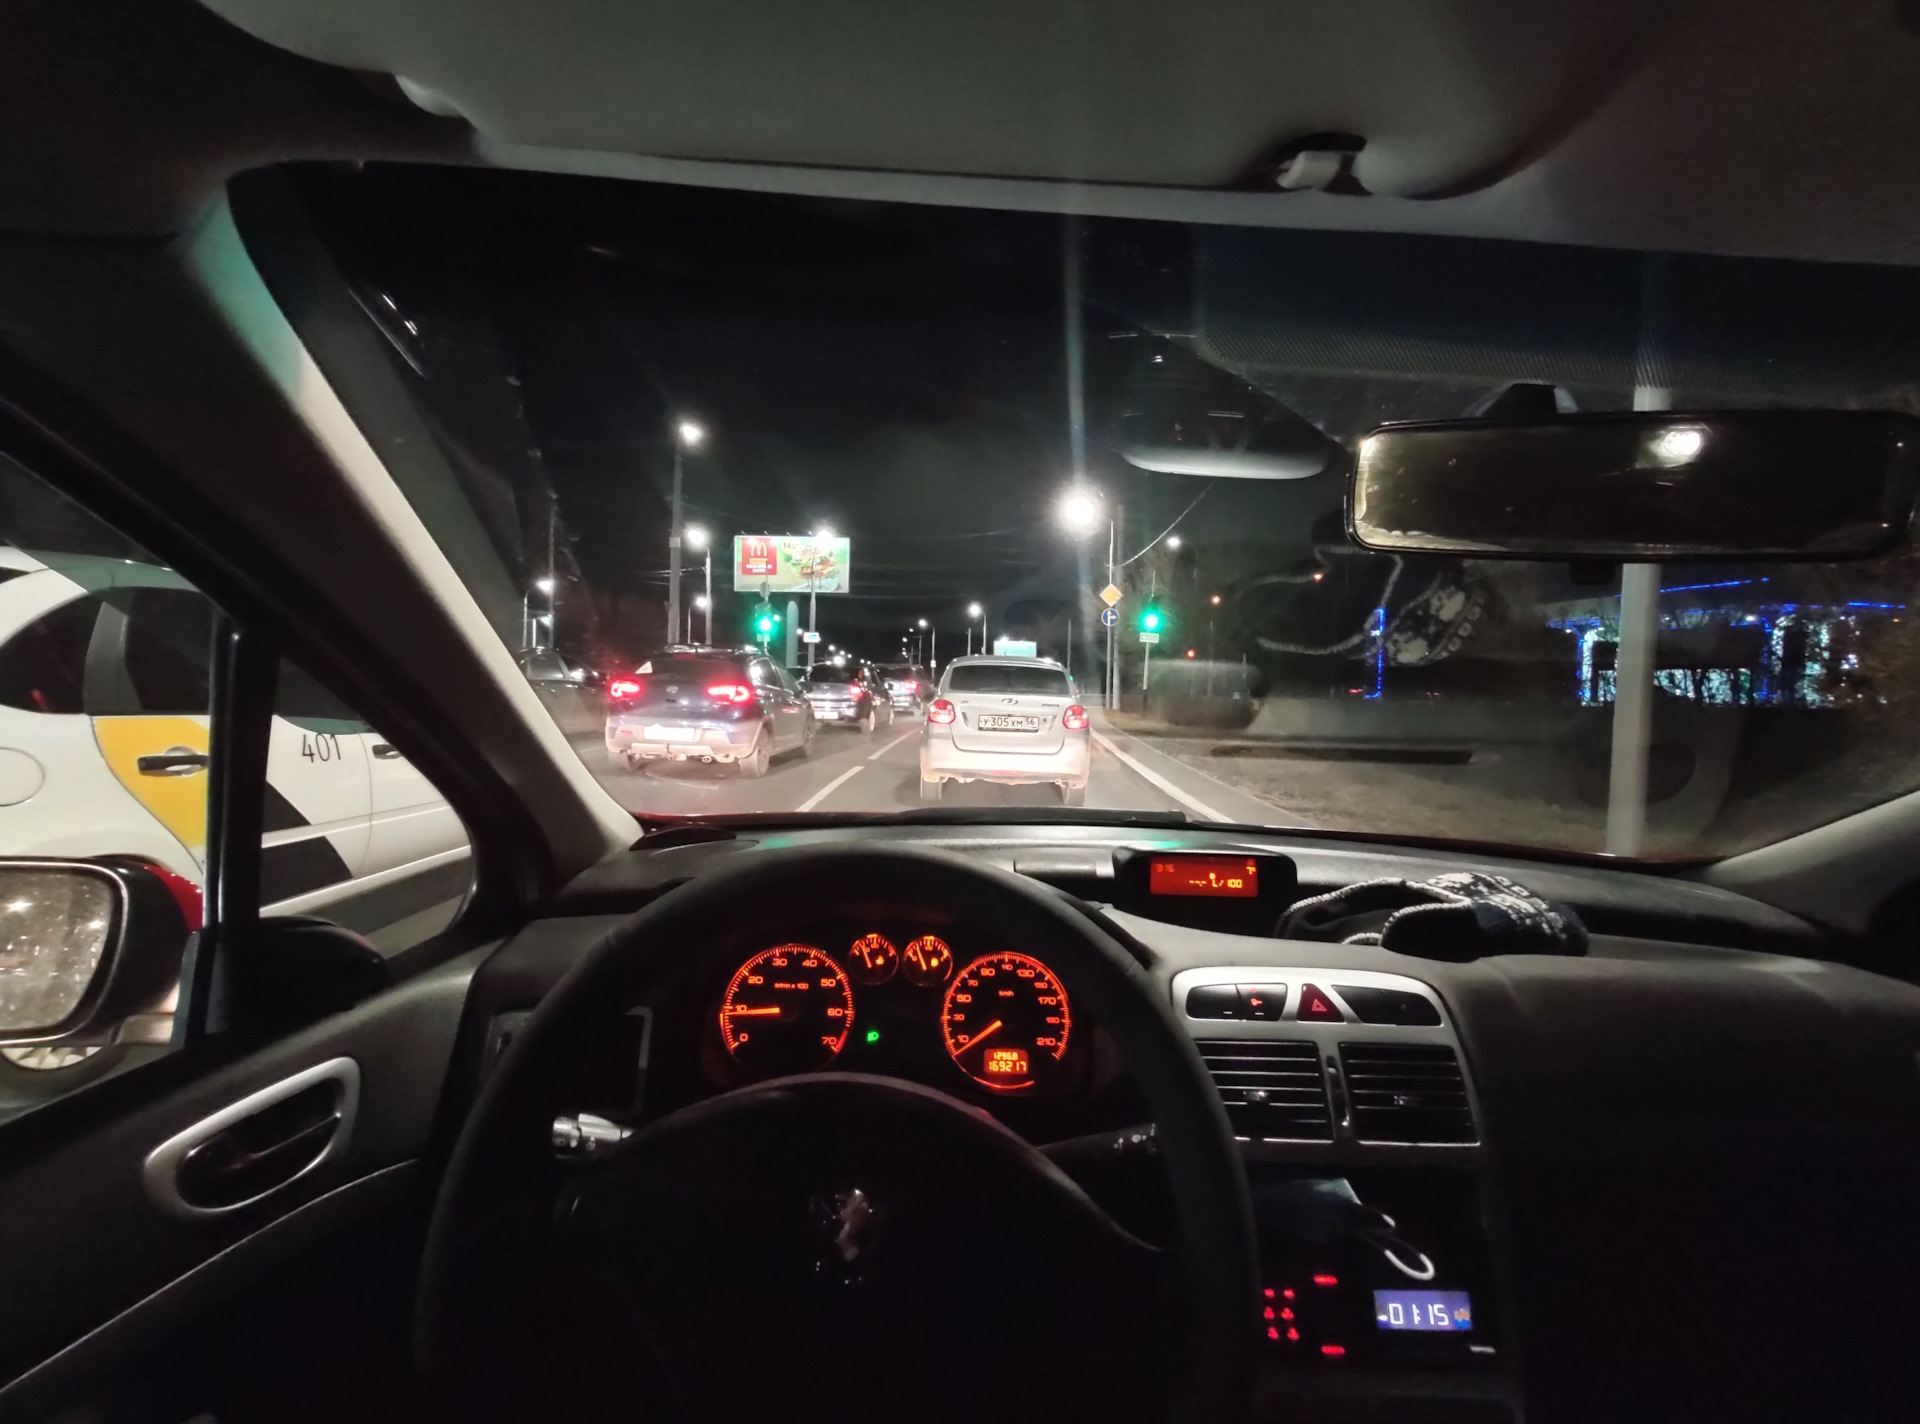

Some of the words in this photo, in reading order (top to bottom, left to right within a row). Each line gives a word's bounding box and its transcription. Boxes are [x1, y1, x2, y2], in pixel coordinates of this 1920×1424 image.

[302, 733, 341, 763] 401
[772, 958, 787, 966] 30
[802, 959, 817, 967] 40
[980, 968, 995, 976] 90
[1016, 969, 1035, 978] 130
[748, 976, 763, 984] 20
[820, 978, 836, 987] 50
[956, 994, 971, 1002] 50
[1038, 997, 1056, 1005] 170
[827, 1008, 843, 1016] 60
[740, 1033, 748, 1042] 0
[821, 1036, 837, 1045] 70
[957, 1035, 969, 1043] 10
[1036, 1037, 1056, 1046] 210
[988, 1061, 1026, 1071] 169217
